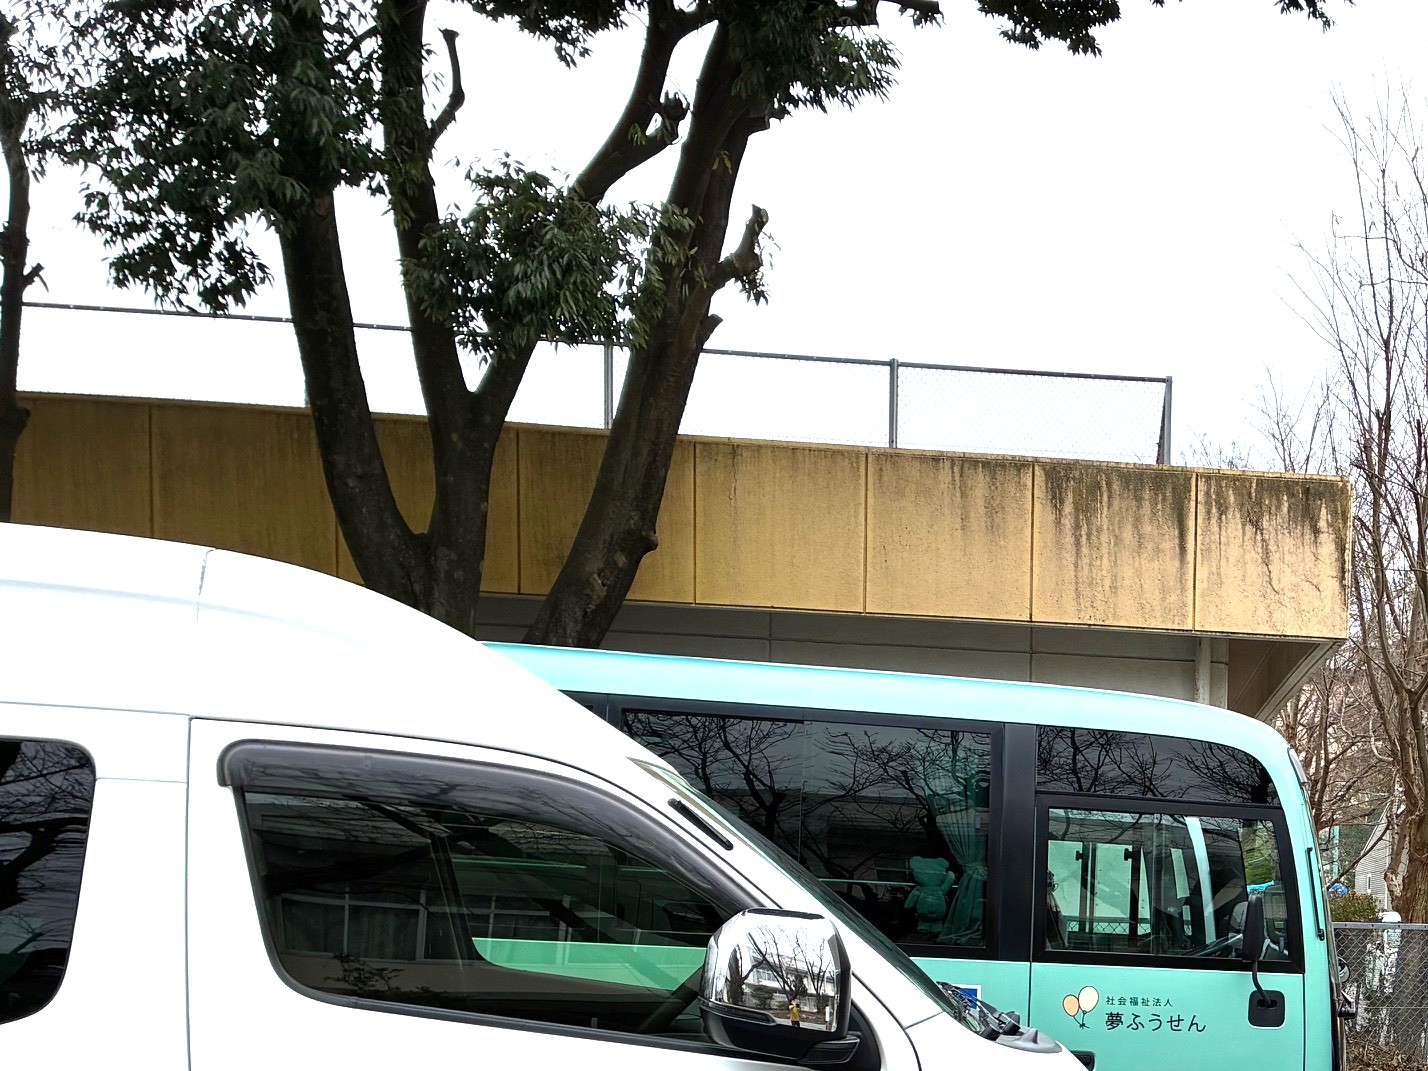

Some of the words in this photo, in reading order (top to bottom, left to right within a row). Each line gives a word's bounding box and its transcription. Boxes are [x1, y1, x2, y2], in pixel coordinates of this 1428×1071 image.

[1105, 995, 1173, 1008] 社会福祉法人
[1105, 1011, 1207, 1033] 夢ふうせん
